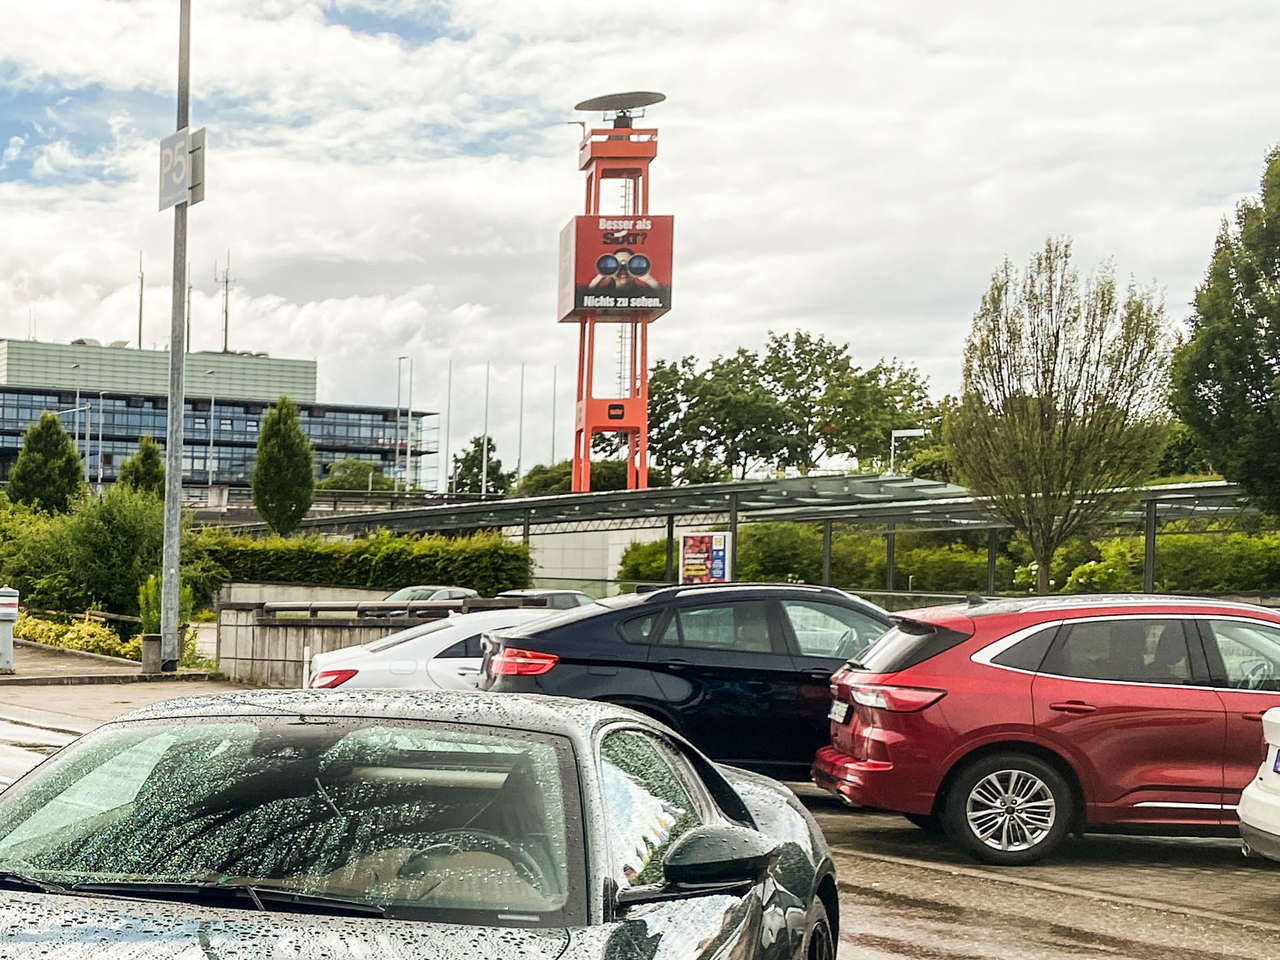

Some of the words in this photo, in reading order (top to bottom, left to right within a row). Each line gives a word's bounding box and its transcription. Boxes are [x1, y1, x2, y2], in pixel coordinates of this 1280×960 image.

[161, 140, 187, 191] P5
[598, 218, 634, 230] Besser
[635, 218, 652, 230] als
[583, 295, 615, 307] Nichts
[616, 297, 629, 307] zu
[629, 295, 663, 308] sehen.
